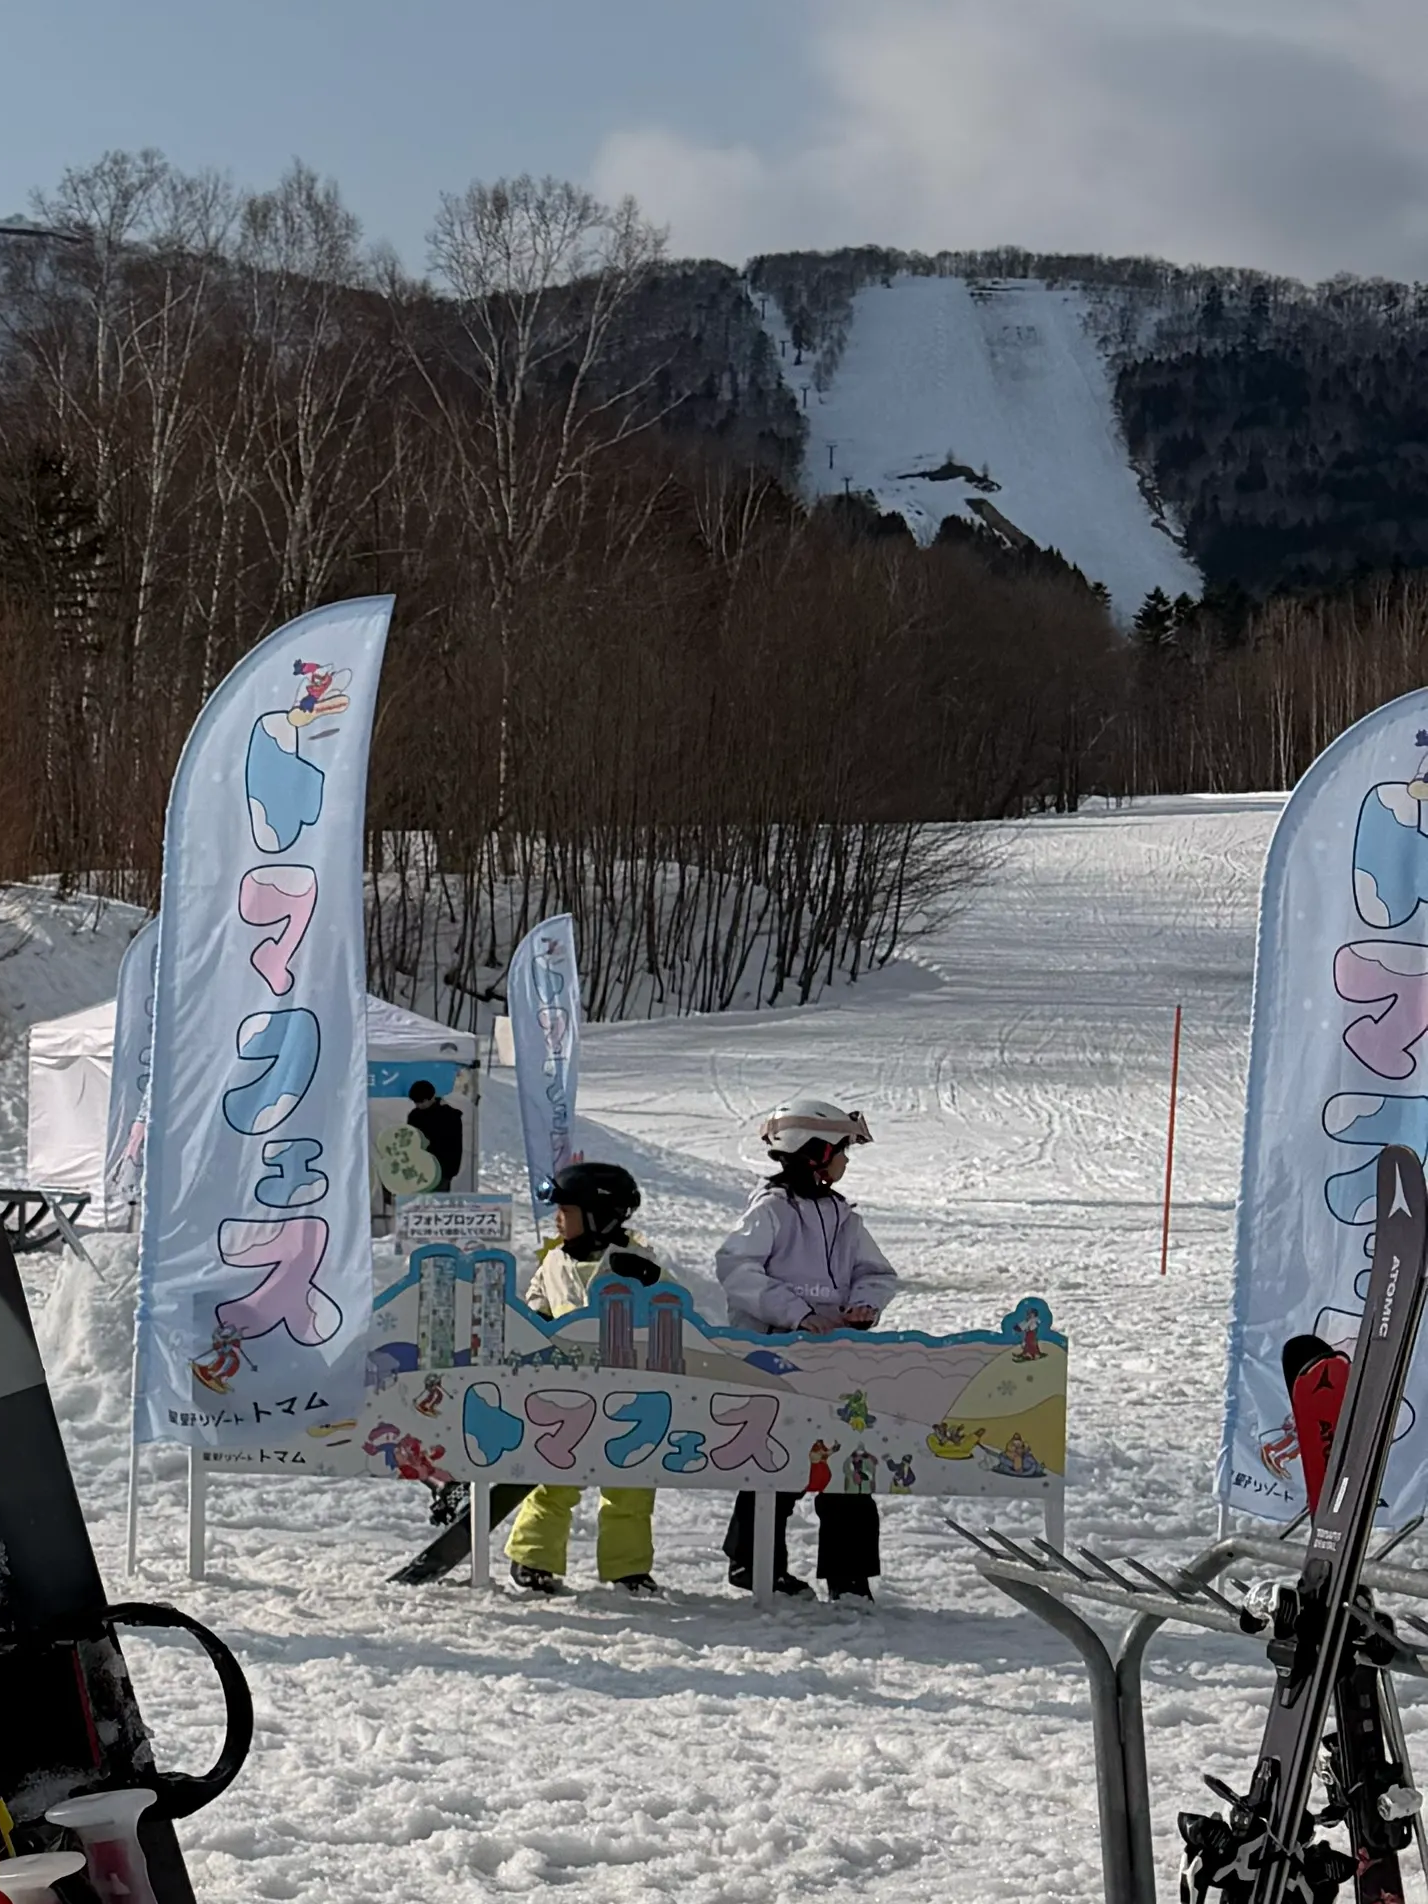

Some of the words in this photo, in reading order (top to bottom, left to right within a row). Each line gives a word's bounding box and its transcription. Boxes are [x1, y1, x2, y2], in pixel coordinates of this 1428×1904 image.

[214, 709, 342, 1347] トマフェス
[1312, 782, 1428, 1448] トマフ
[1378, 1255, 1401, 1338] ATOMIC
[252, 1391, 329, 1423] トマム
[462, 1381, 790, 1473] トマフェス
[259, 1449, 306, 1464] トマム
[1231, 1468, 1294, 1504] 野リゾート
